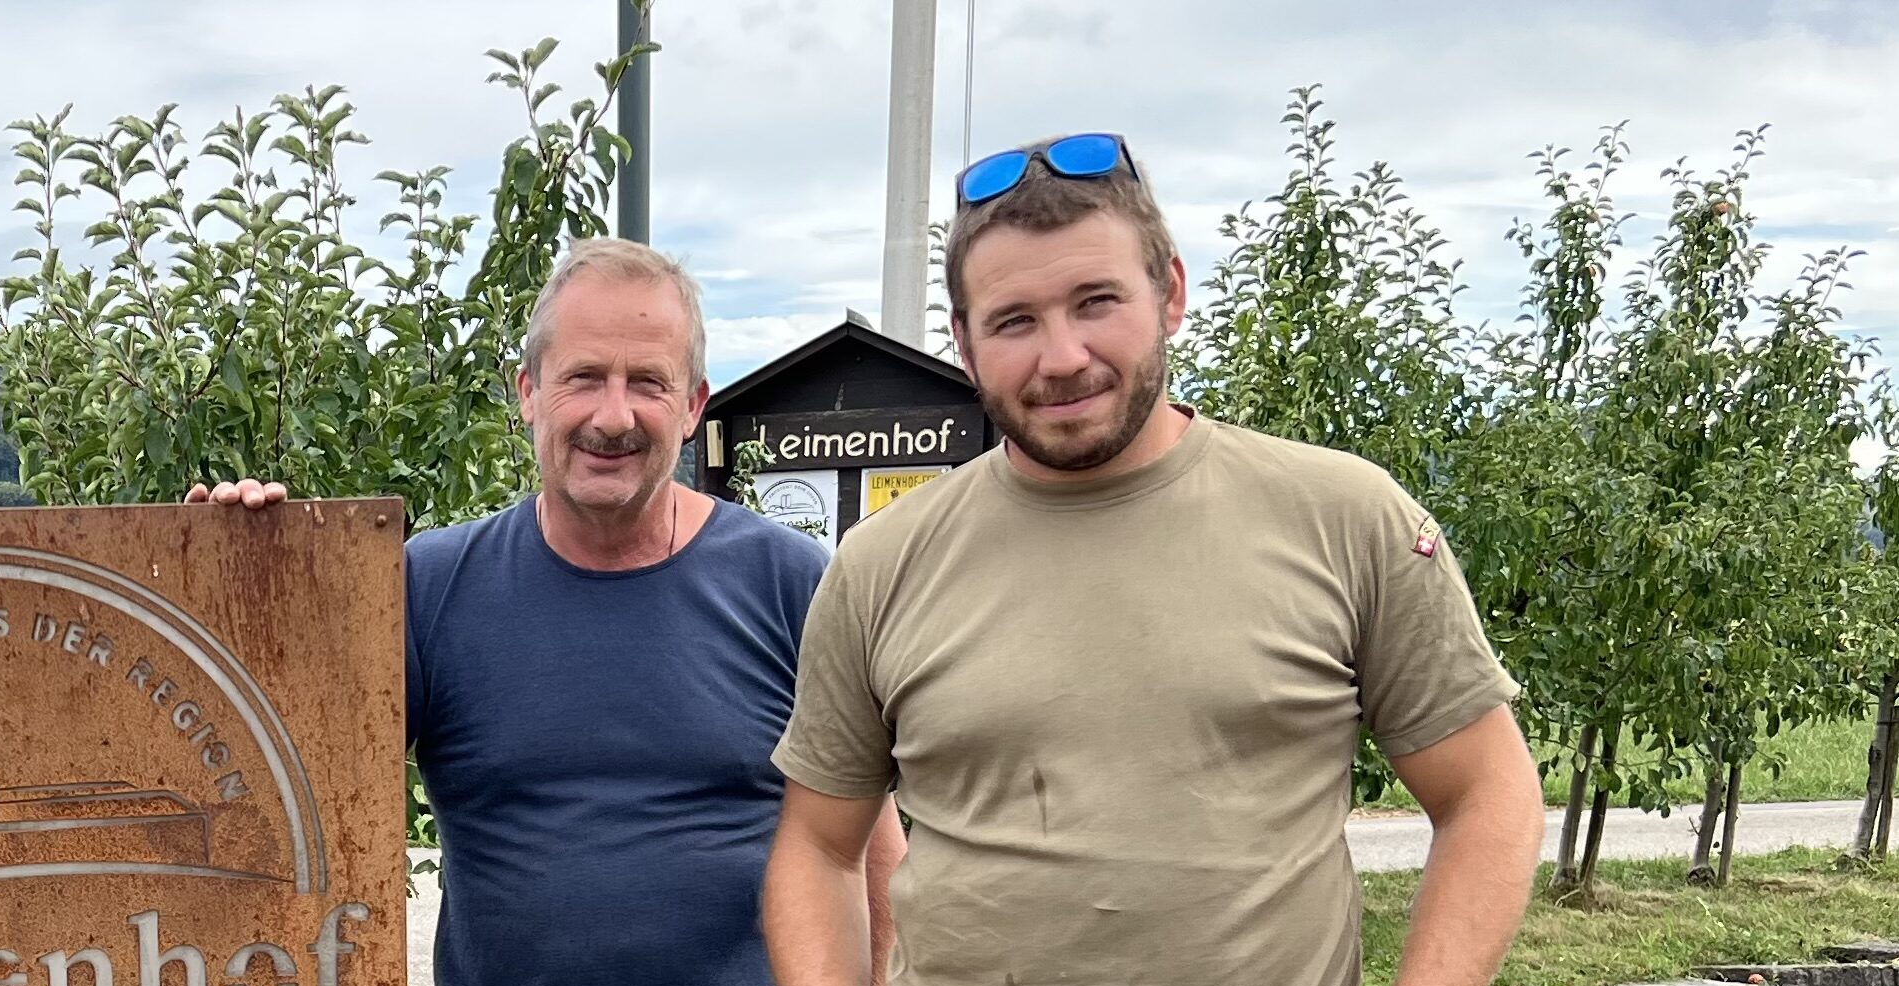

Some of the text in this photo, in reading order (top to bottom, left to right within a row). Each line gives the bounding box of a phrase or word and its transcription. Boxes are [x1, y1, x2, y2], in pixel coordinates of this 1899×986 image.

[759, 418, 954, 459] Leimenhof
[32, 613, 115, 667] DER
[125, 655, 250, 801] REGION
